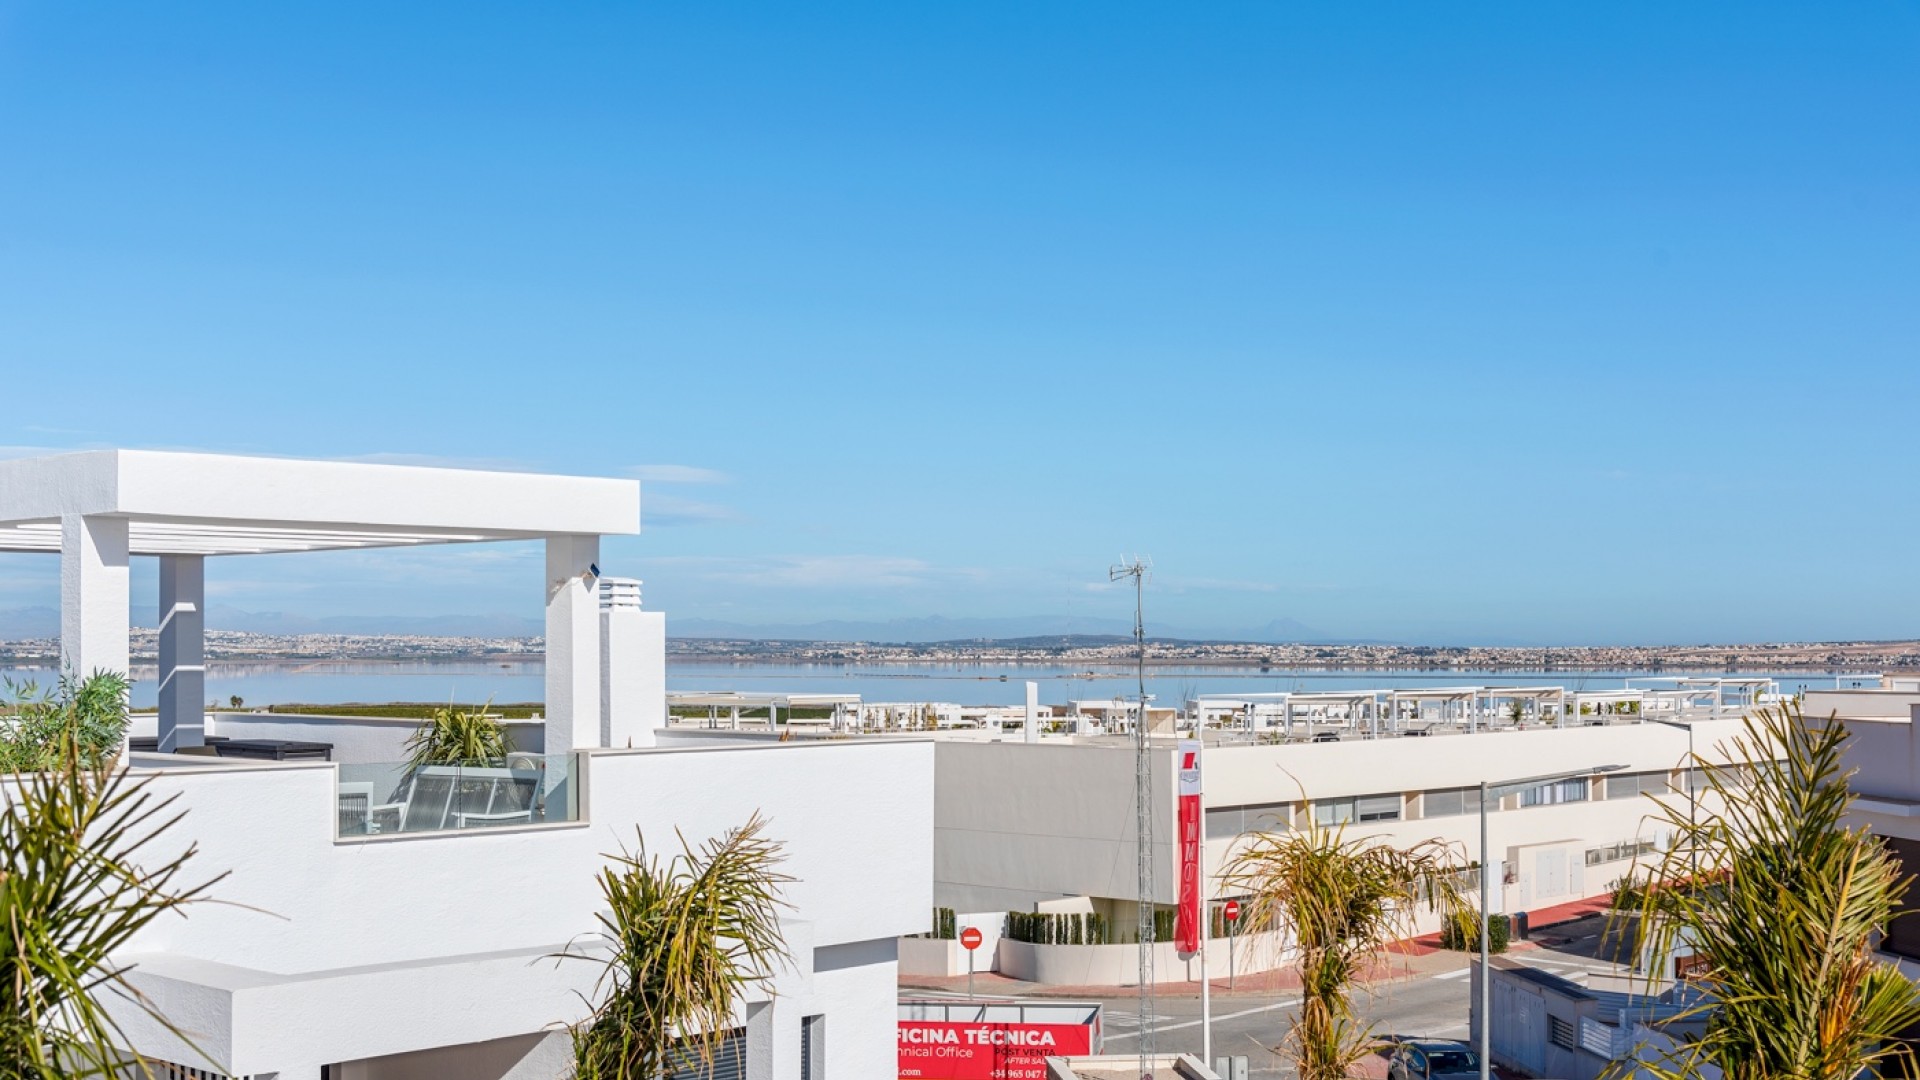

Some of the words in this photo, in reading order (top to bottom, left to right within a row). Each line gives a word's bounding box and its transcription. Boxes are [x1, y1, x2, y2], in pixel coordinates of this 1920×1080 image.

[964, 1025, 1056, 1046] TÉCNICA
[936, 1046, 973, 1058] Office
[995, 1047, 1020, 1056] POST
[1022, 1048, 1056, 1057] VENTA
[1004, 1057, 1030, 1065] AFTER
[898, 1068, 921, 1076] .com
[990, 1069, 1006, 1078] +34
[1007, 1069, 1024, 1079] 965
